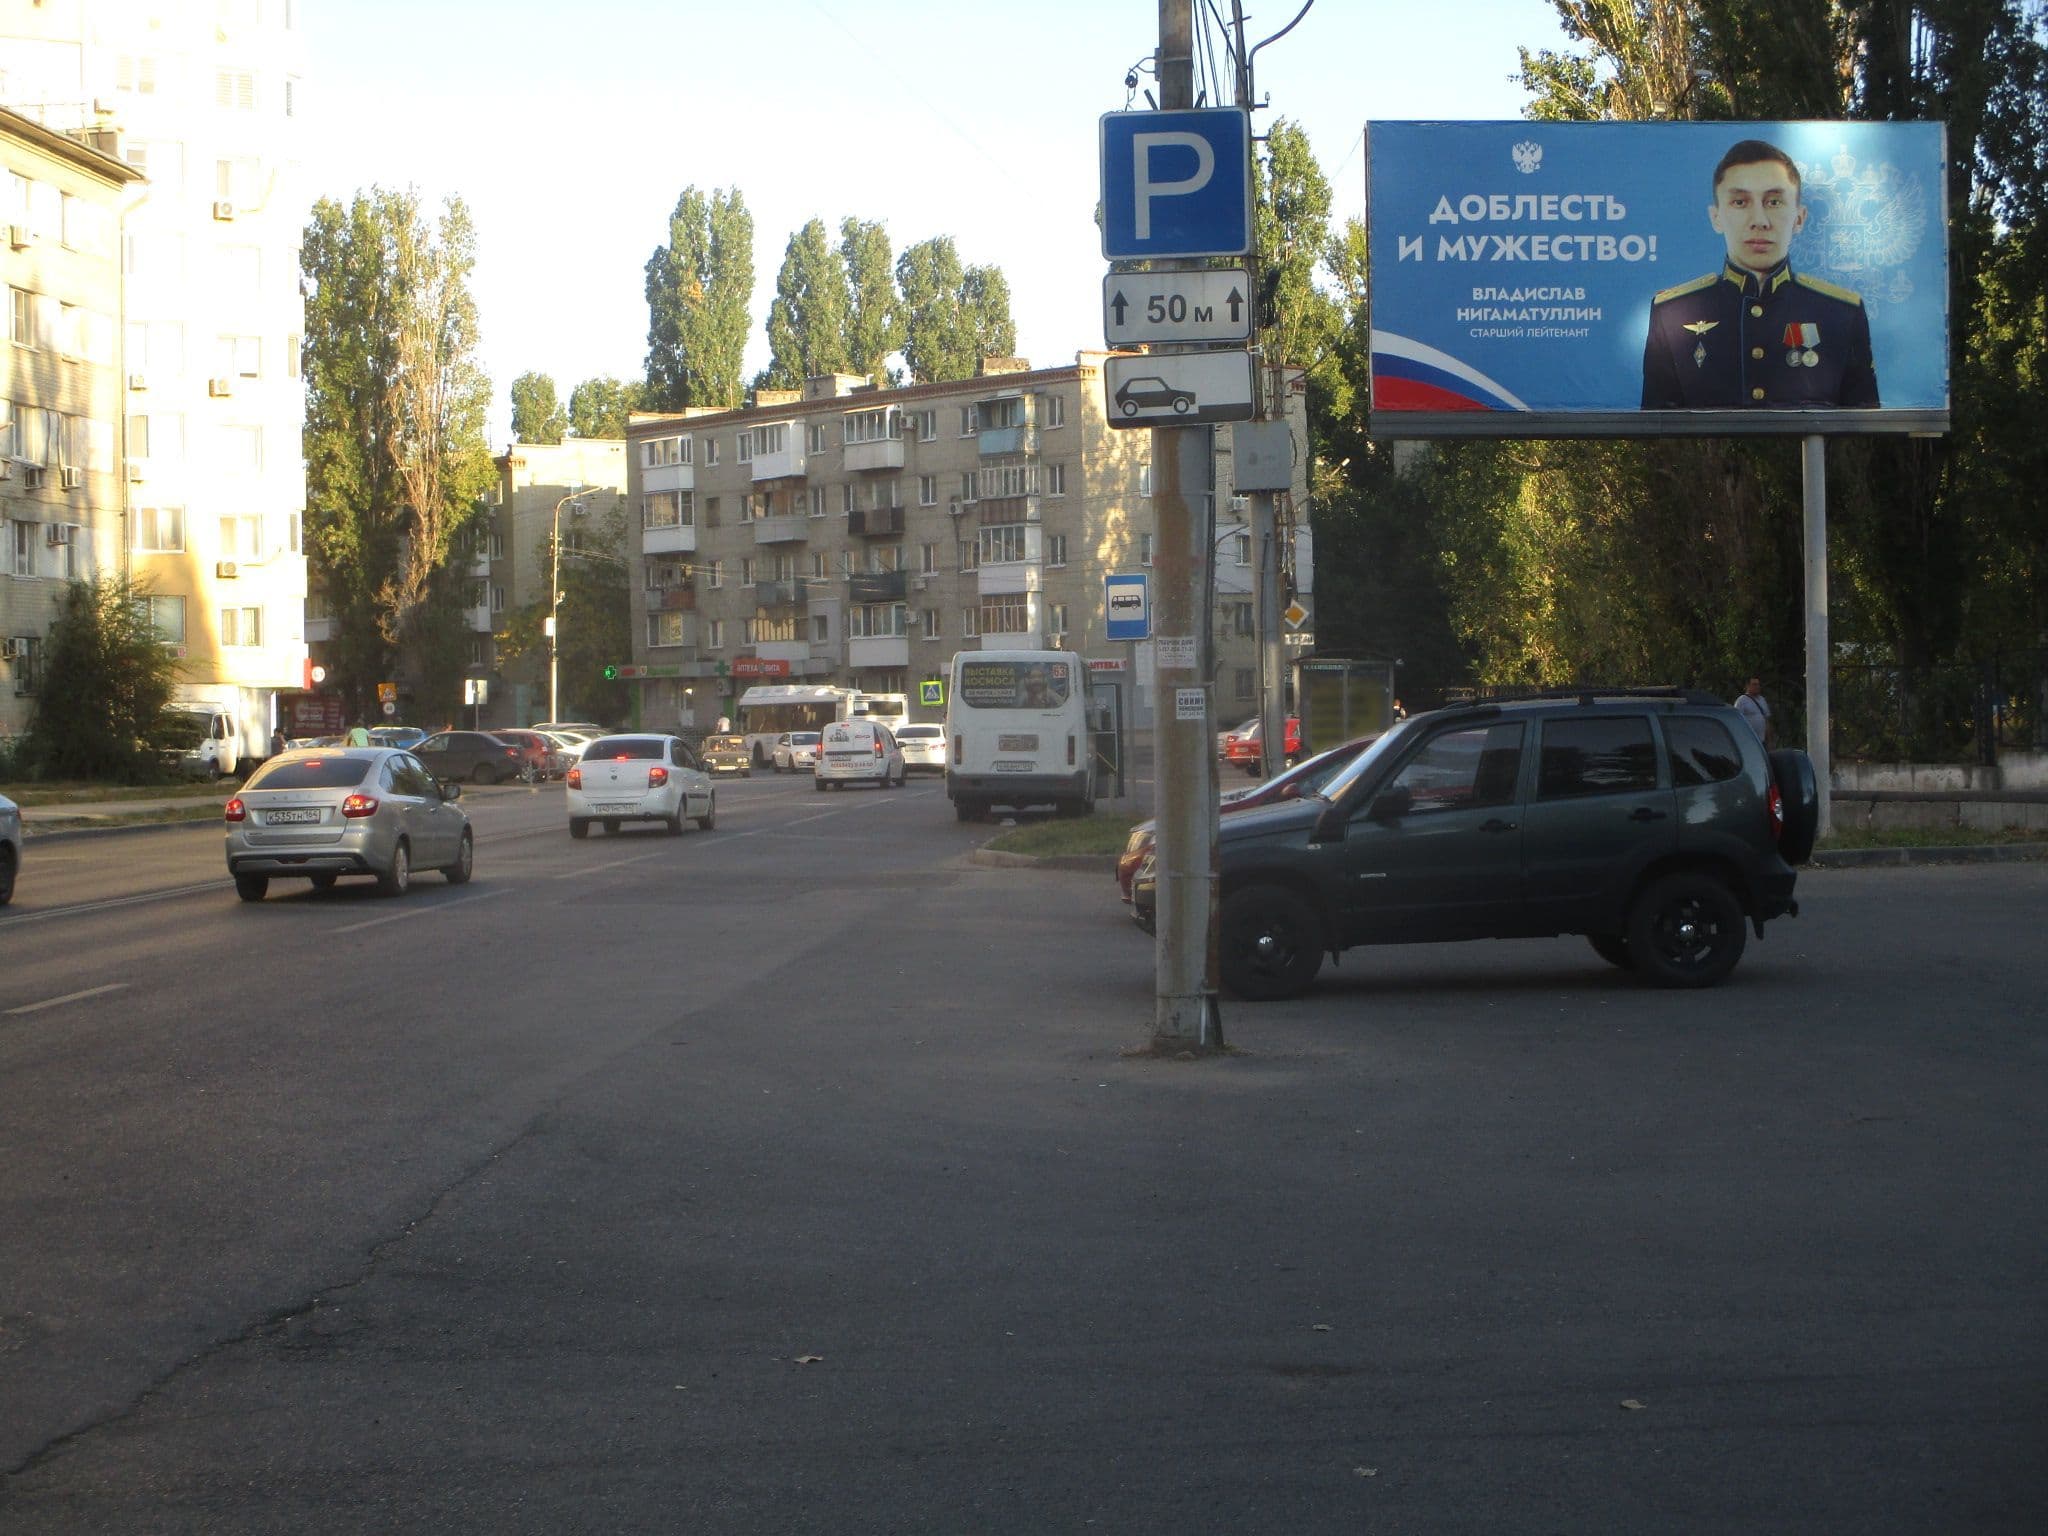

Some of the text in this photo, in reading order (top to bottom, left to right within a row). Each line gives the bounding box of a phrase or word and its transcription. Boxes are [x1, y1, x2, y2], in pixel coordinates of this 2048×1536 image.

[1133, 131, 1215, 240] P
[1429, 194, 1626, 225] ДОБЛЕСТЬ
[1399, 235, 1657, 262] И МУЖЕСТВО!
[1472, 287, 1586, 302] ВЛАДИСЛАВ
[1147, 294, 1187, 324] 50
[1456, 307, 1602, 321] НИГАМАТУЛЛИН
[1470, 326, 1589, 338] СТАРШИЙ ЛЕЙТЕНАНТ
[736, 663, 759, 673] АПТЕКА
[1087, 660, 1120, 670] АПТЕКА
